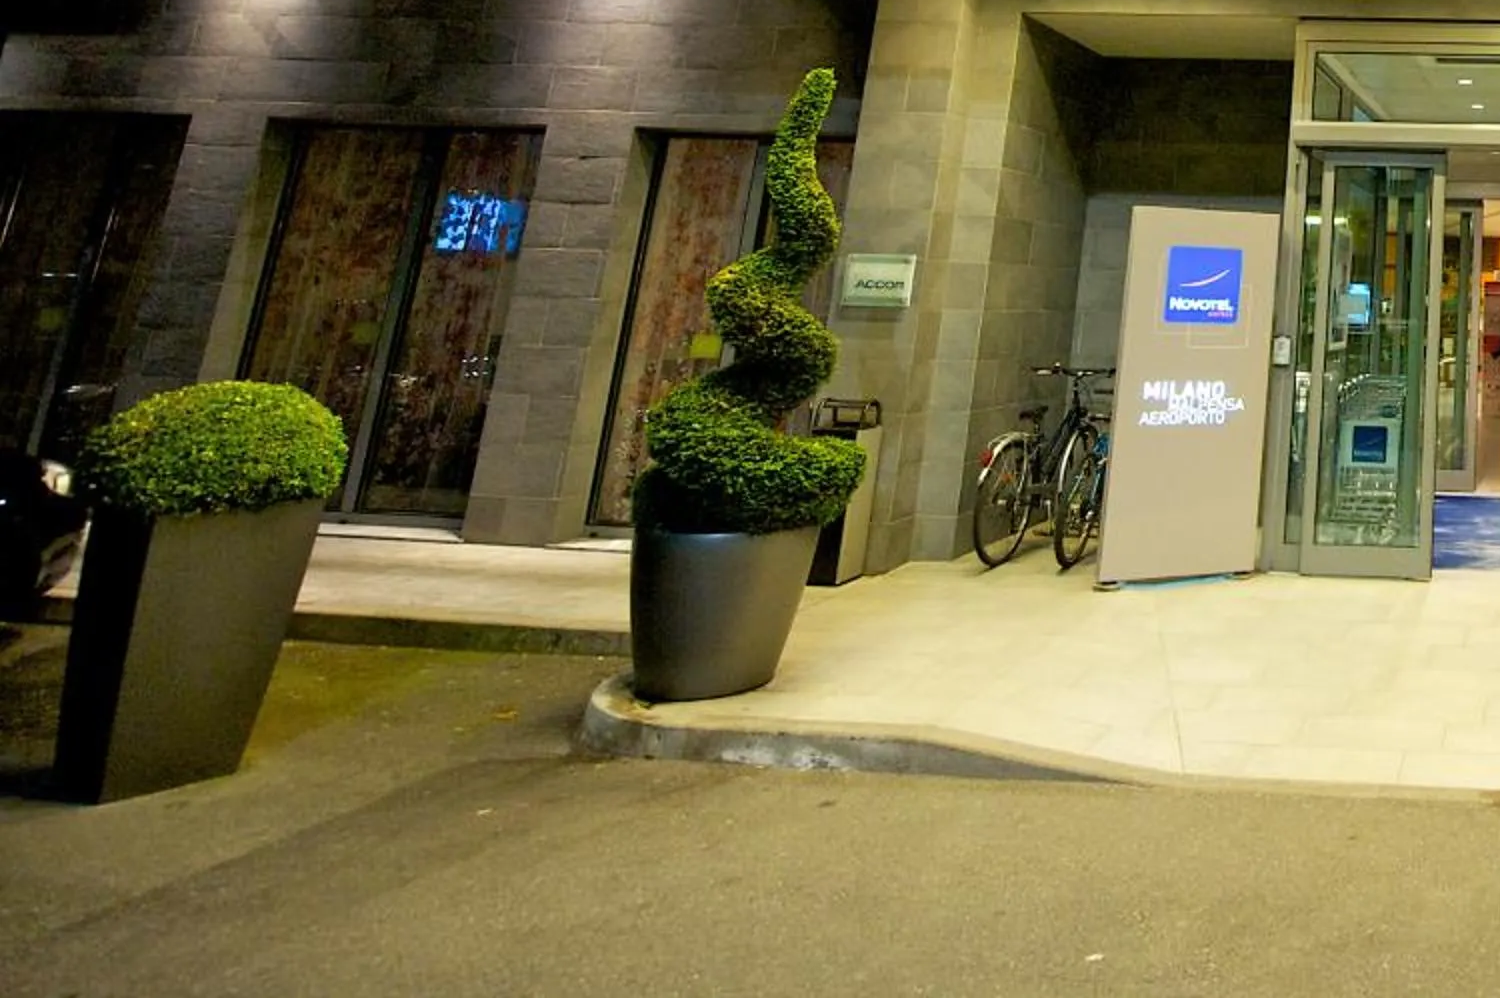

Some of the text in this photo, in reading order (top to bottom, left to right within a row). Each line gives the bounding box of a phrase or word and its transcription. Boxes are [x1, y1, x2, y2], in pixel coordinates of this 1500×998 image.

[1169, 296, 1234, 311] NOVOTEL
[1143, 380, 1225, 401] MILANO
[1139, 409, 1225, 426] AEROPORTO
